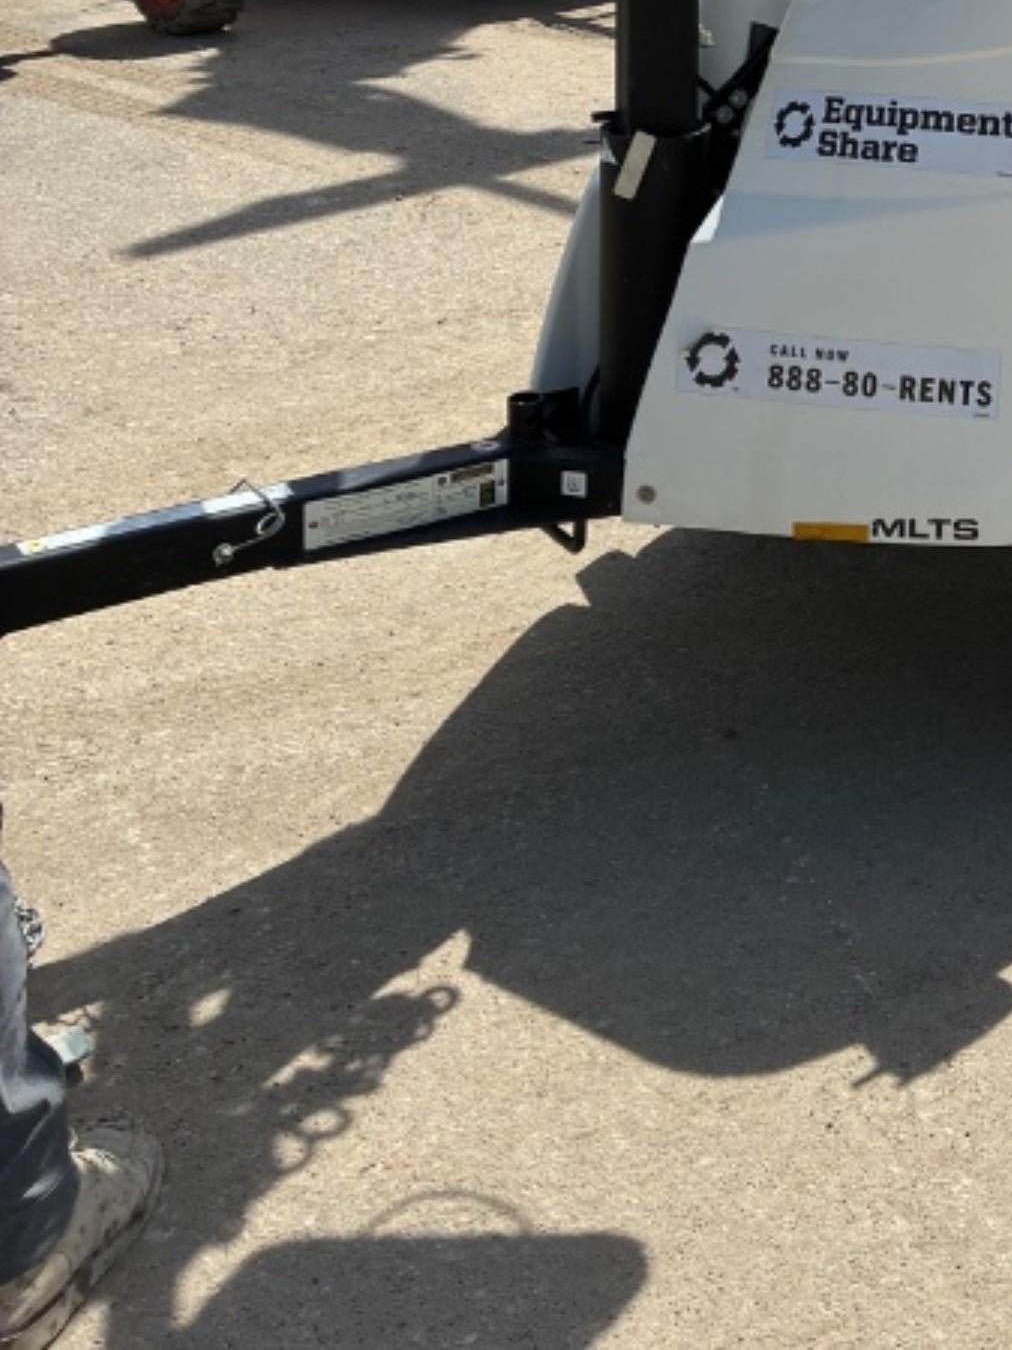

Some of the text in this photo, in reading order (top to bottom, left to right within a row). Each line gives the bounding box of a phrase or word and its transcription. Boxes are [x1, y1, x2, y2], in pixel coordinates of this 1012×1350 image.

[816, 130, 919, 164] Share
[769, 344, 850, 363] CALL NOW
[767, 363, 993, 408] 888-80-RENTS
[871, 518, 980, 541] MLTS
